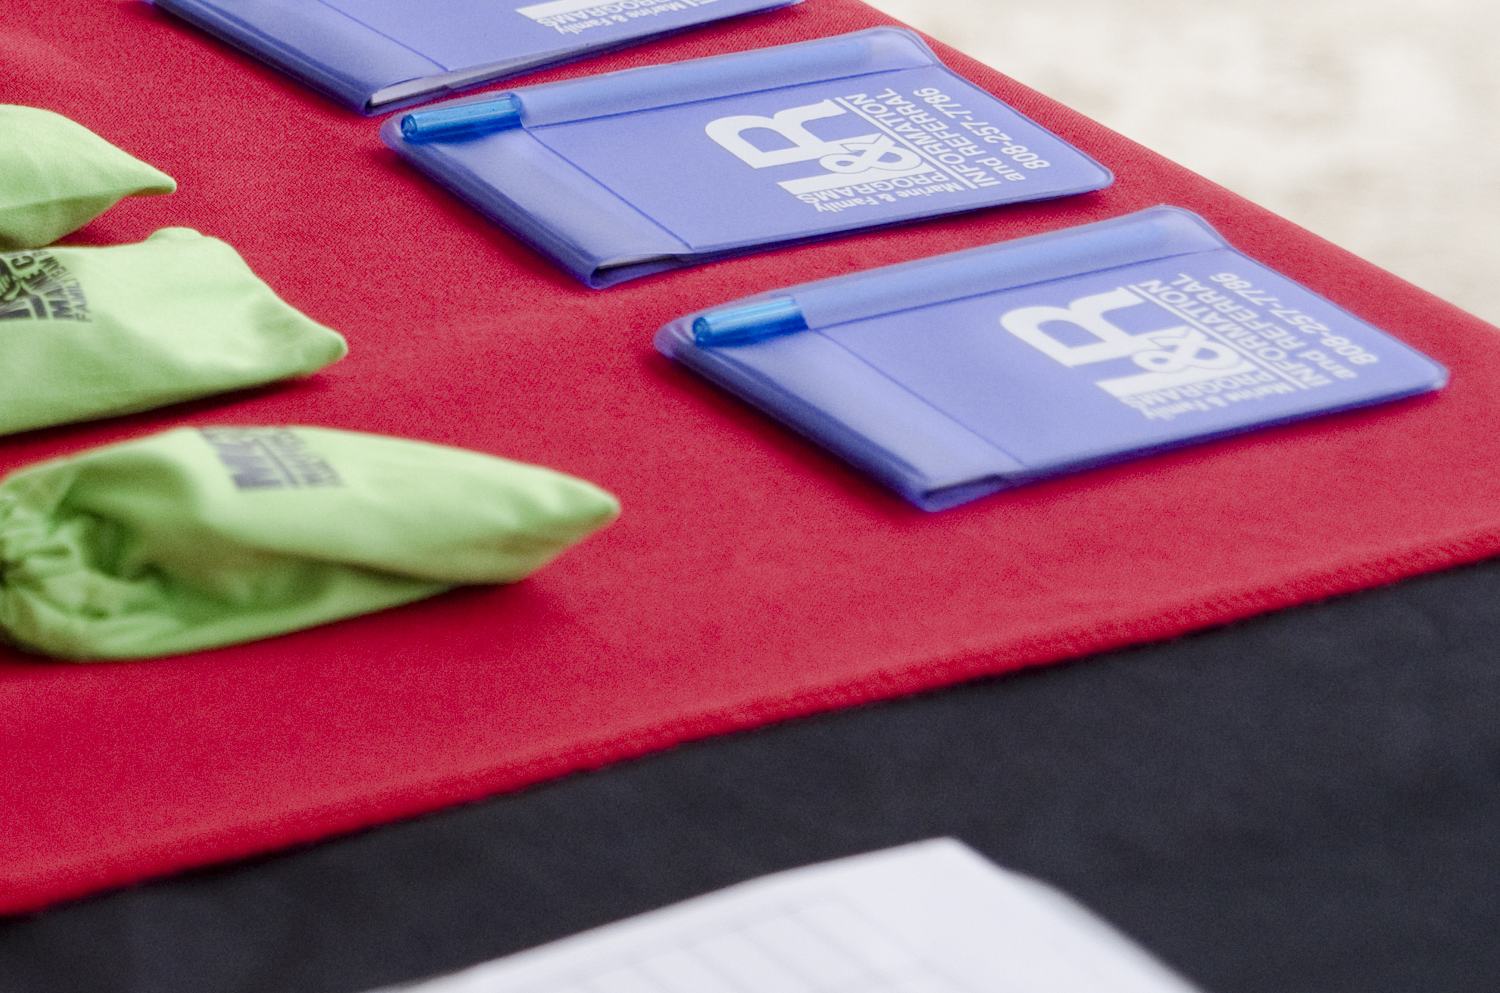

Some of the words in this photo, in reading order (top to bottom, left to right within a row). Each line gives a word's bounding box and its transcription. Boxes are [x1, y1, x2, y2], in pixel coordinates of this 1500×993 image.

[705, 100, 937, 196] I&R
[845, 94, 1001, 187] INFORMATION
[876, 88, 986, 156] REFERRAL
[913, 88, 1050, 169] 808-257-7786
[796, 170, 949, 203] PROGRAMS
[815, 196, 880, 213] Family
[895, 181, 965, 198] Marine
[975, 157, 1025, 181] and
[1000, 285, 1258, 398] I&R
[1138, 280, 1332, 386] INFORMATION
[1171, 274, 1306, 351] REFERRAL
[1209, 273, 1378, 365] 808-257-7786
[1118, 369, 1276, 408] PROGRAMS
[1297, 350, 1356, 379] and
